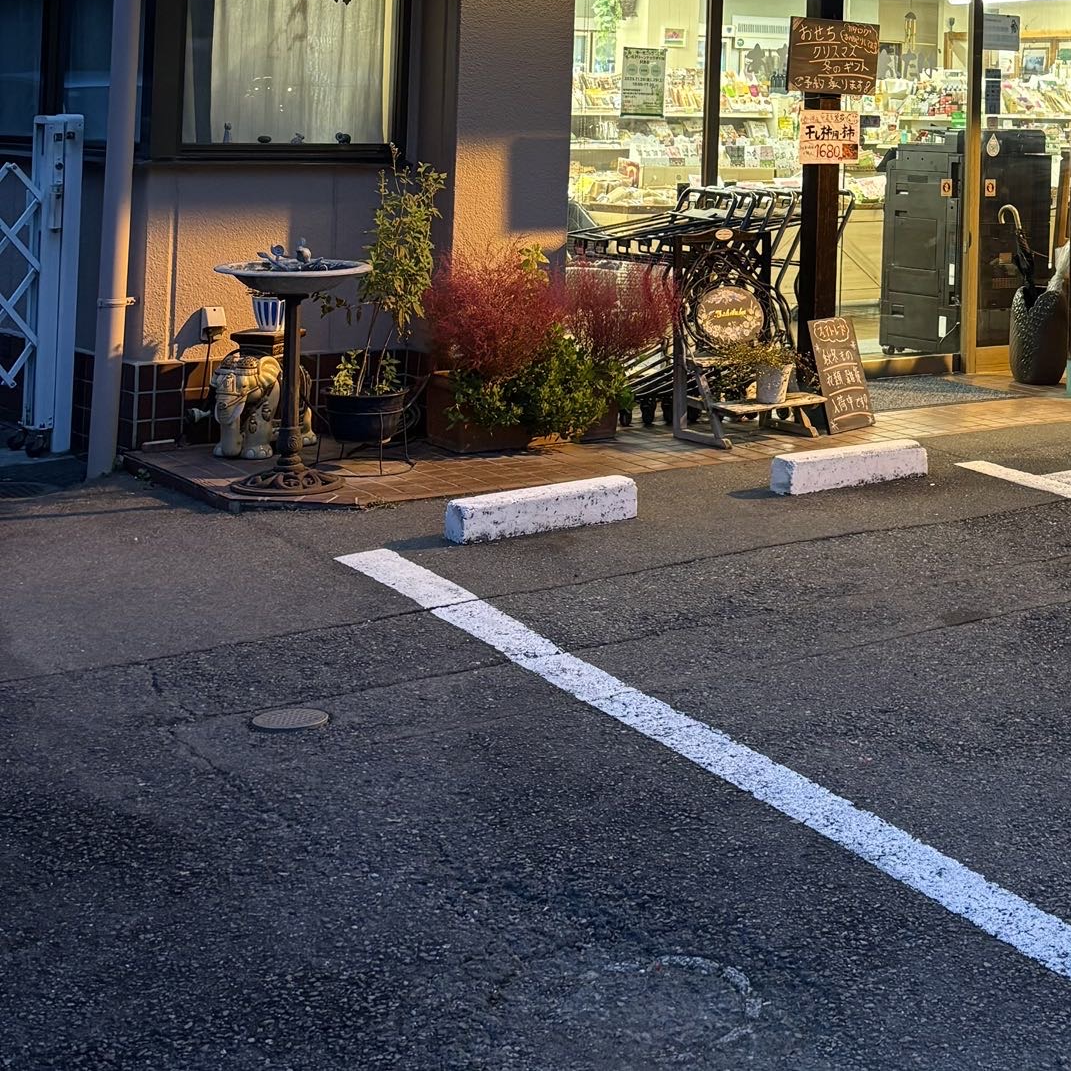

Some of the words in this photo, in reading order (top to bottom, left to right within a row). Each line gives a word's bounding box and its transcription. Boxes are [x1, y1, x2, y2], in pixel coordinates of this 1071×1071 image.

[798, 24, 836, 42] おせち
[813, 45, 857, 59] クリスマス
[822, 59, 869, 75] 冬のギフト
